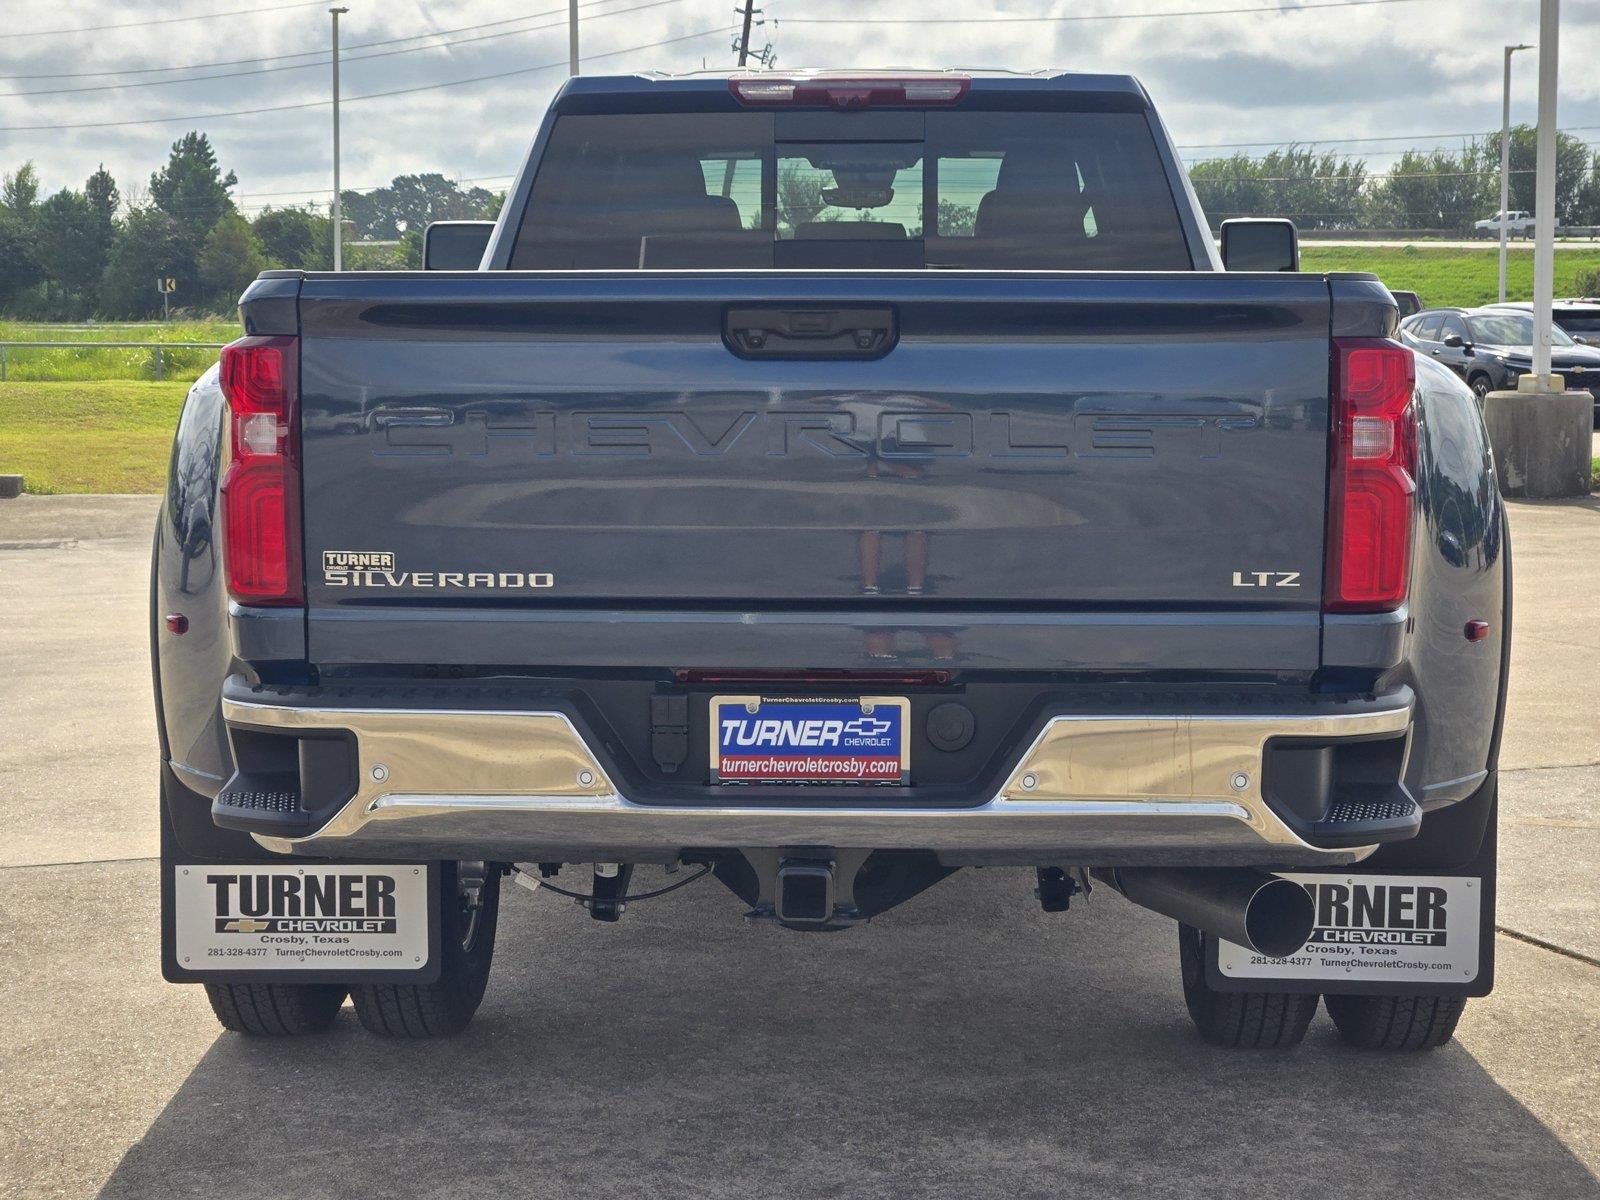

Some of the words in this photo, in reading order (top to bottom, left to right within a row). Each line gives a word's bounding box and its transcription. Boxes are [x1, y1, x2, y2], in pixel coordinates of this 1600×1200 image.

[369, 410, 1256, 459] CHEVROLET
[326, 553, 392, 566] TURNER
[324, 571, 554, 588] SILVERADO
[1232, 571, 1301, 587] LTZ
[721, 720, 844, 746] TURNER
[844, 737, 891, 746] CHEVROLET
[721, 757, 898, 777] turnerchevroletcrosby.com
[207, 874, 396, 918] TURNER
[1303, 883, 1448, 930] RNER
[277, 920, 386, 932] CHEVROLET
[260, 935, 309, 945] Crosby,
[312, 935, 350, 944] Texas
[1323, 930, 1436, 944] CHEVROLET
[207, 948, 267, 957] 281-328-4377
[276, 948, 403, 958] TurnerChevroletCrosby.com
[1305, 944, 1355, 956] Crosby,
[1359, 946, 1398, 955] Texas
[1250, 956, 1312, 966] 281-328-4377
[1320, 958, 1452, 971] TurnerChevroletCrosby.com
